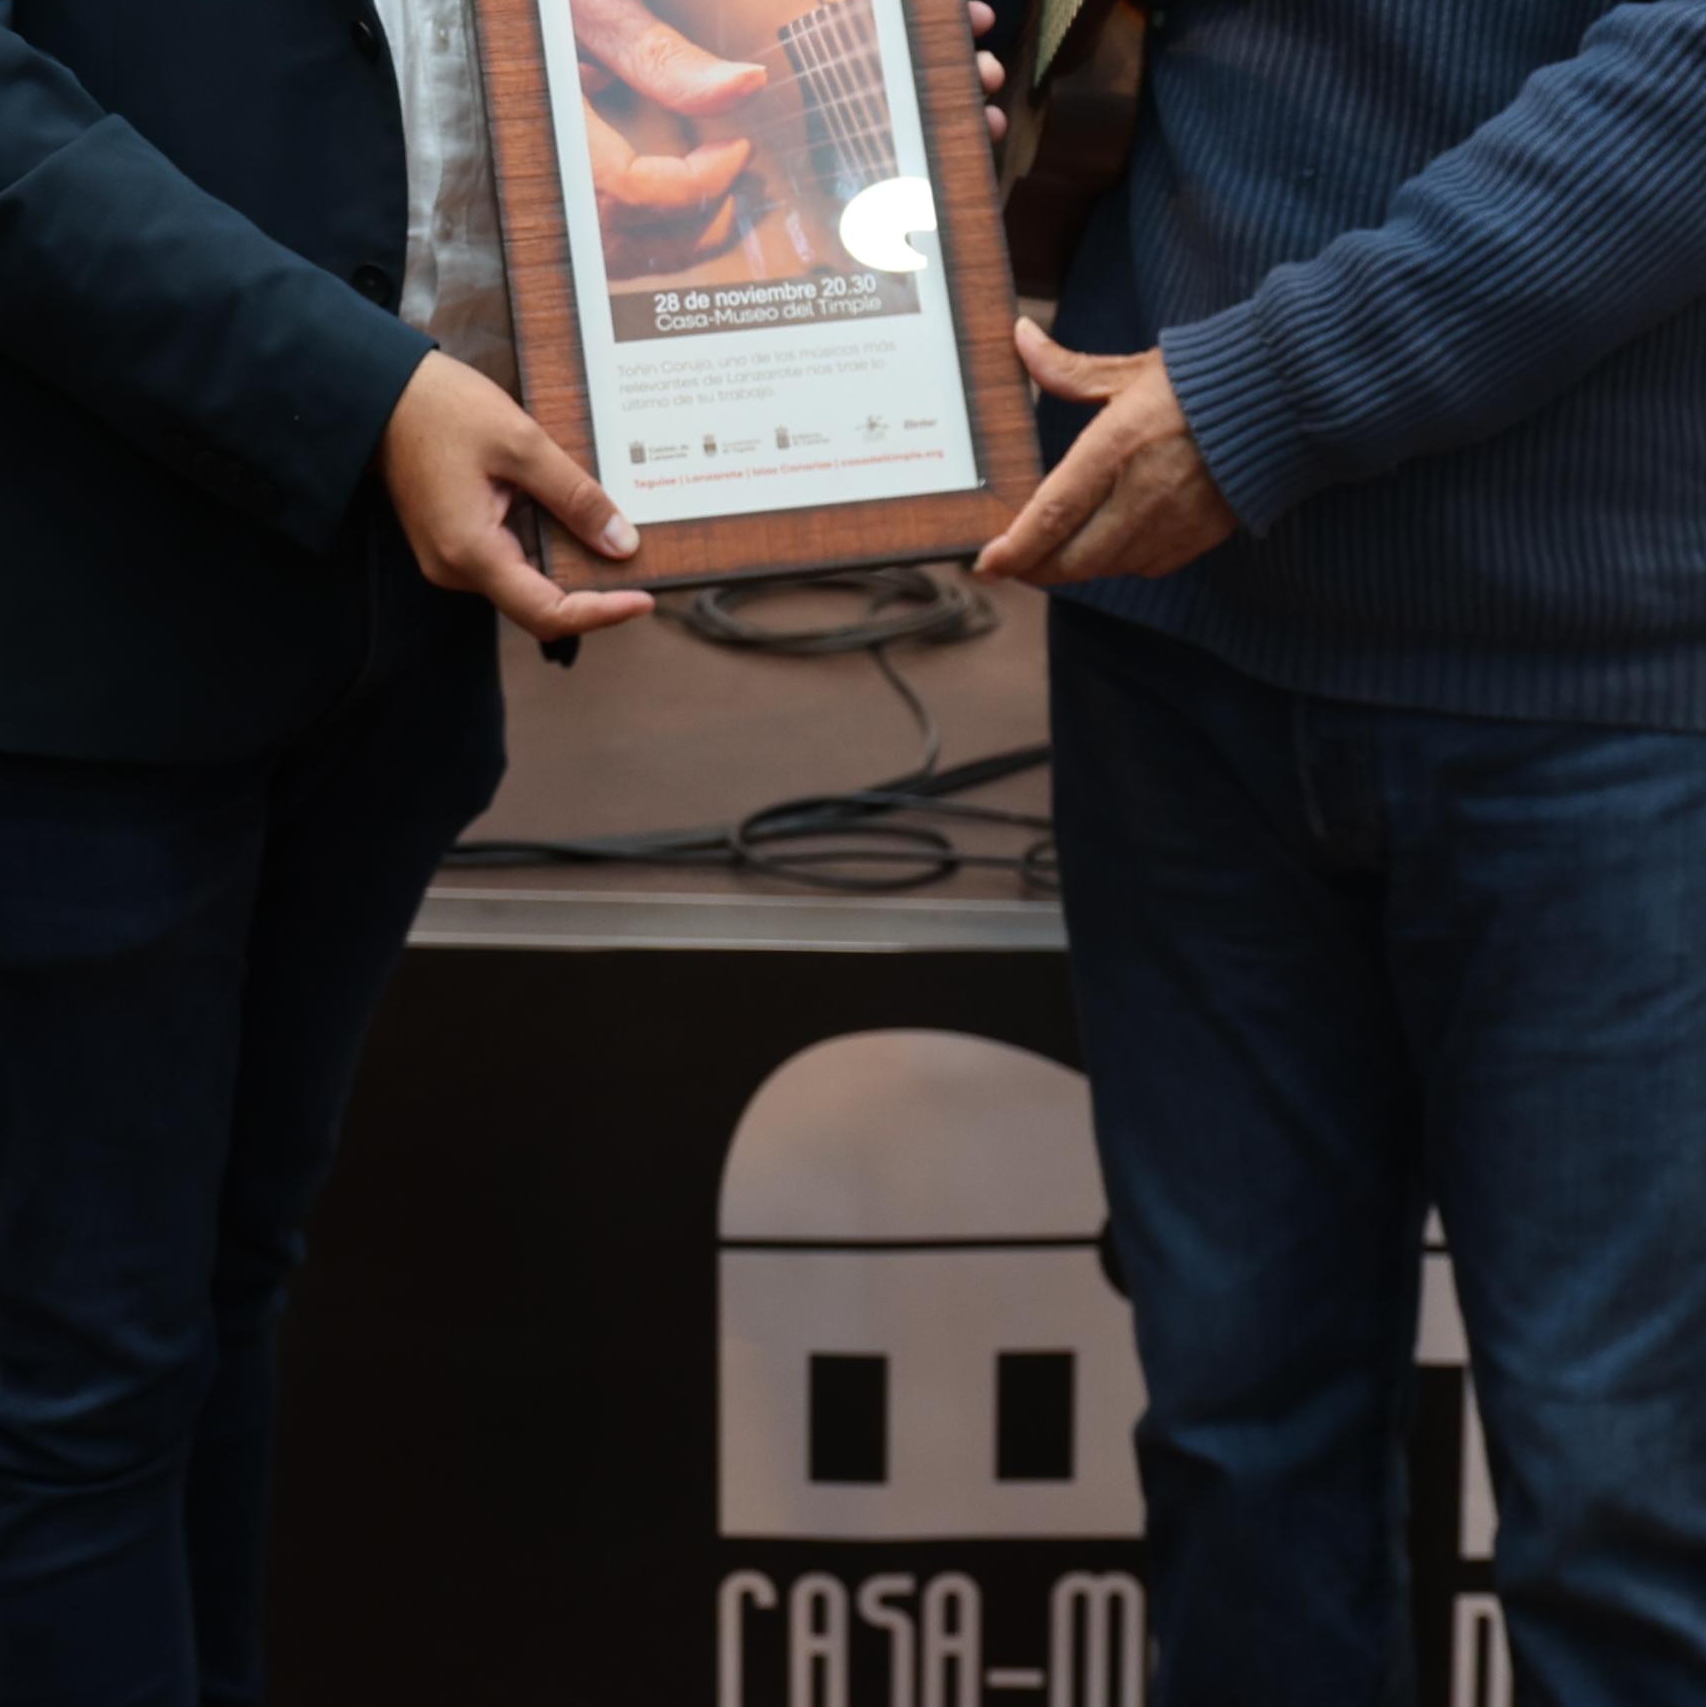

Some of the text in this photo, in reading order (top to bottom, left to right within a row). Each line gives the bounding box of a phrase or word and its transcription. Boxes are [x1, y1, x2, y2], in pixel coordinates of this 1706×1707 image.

[654, 274, 876, 313] 28 de noviembre 20.30
[655, 295, 882, 332] Casa-Museo del Timple
[718, 354, 747, 368] uno
[751, 349, 771, 365] de
[774, 348, 797, 363] los
[618, 376, 699, 395] relevantes
[704, 371, 723, 387] de
[727, 365, 804, 385] Lanzarote
[673, 392, 693, 407] de
[697, 391, 716, 405] su
[717, 1569, 1150, 1707] CASA-M
